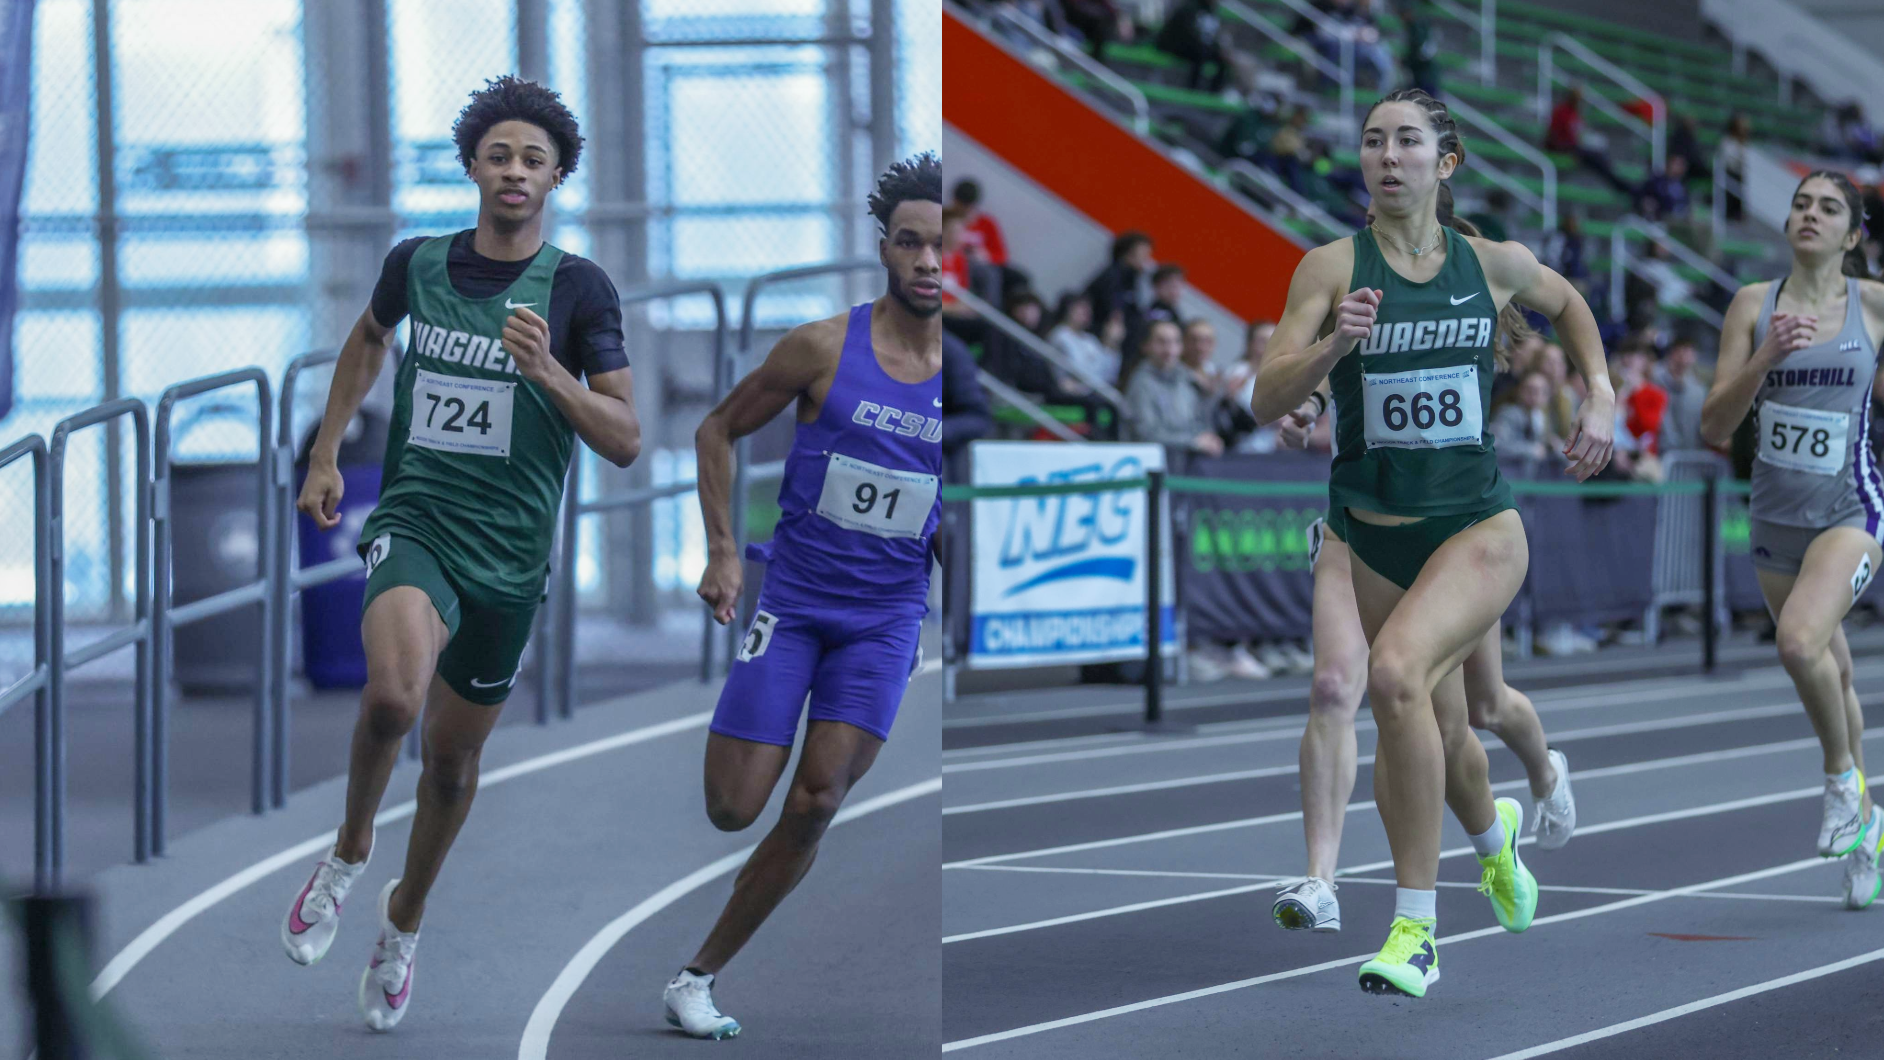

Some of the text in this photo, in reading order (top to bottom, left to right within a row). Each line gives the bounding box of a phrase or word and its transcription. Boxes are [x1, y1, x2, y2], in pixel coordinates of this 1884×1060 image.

[1359, 317, 1492, 356] WAGNER
[454, 383, 494, 392] CONFERENCE
[1378, 372, 1460, 385] NORTHEAST CONFERENCE
[1766, 367, 1855, 388] STONEHILL
[426, 392, 492, 435] 724
[852, 400, 942, 444] CCSU
[1382, 388, 1463, 432] 668
[1434, 435, 1475, 444] CHAMPIONSHIPS
[1771, 421, 1830, 458] 578
[848, 462, 922, 484] NORTHEAST CONFERENCE
[852, 482, 901, 520] 91
[999, 456, 1142, 568] NEC
[984, 612, 1144, 650] CHAMPIONSHIP
